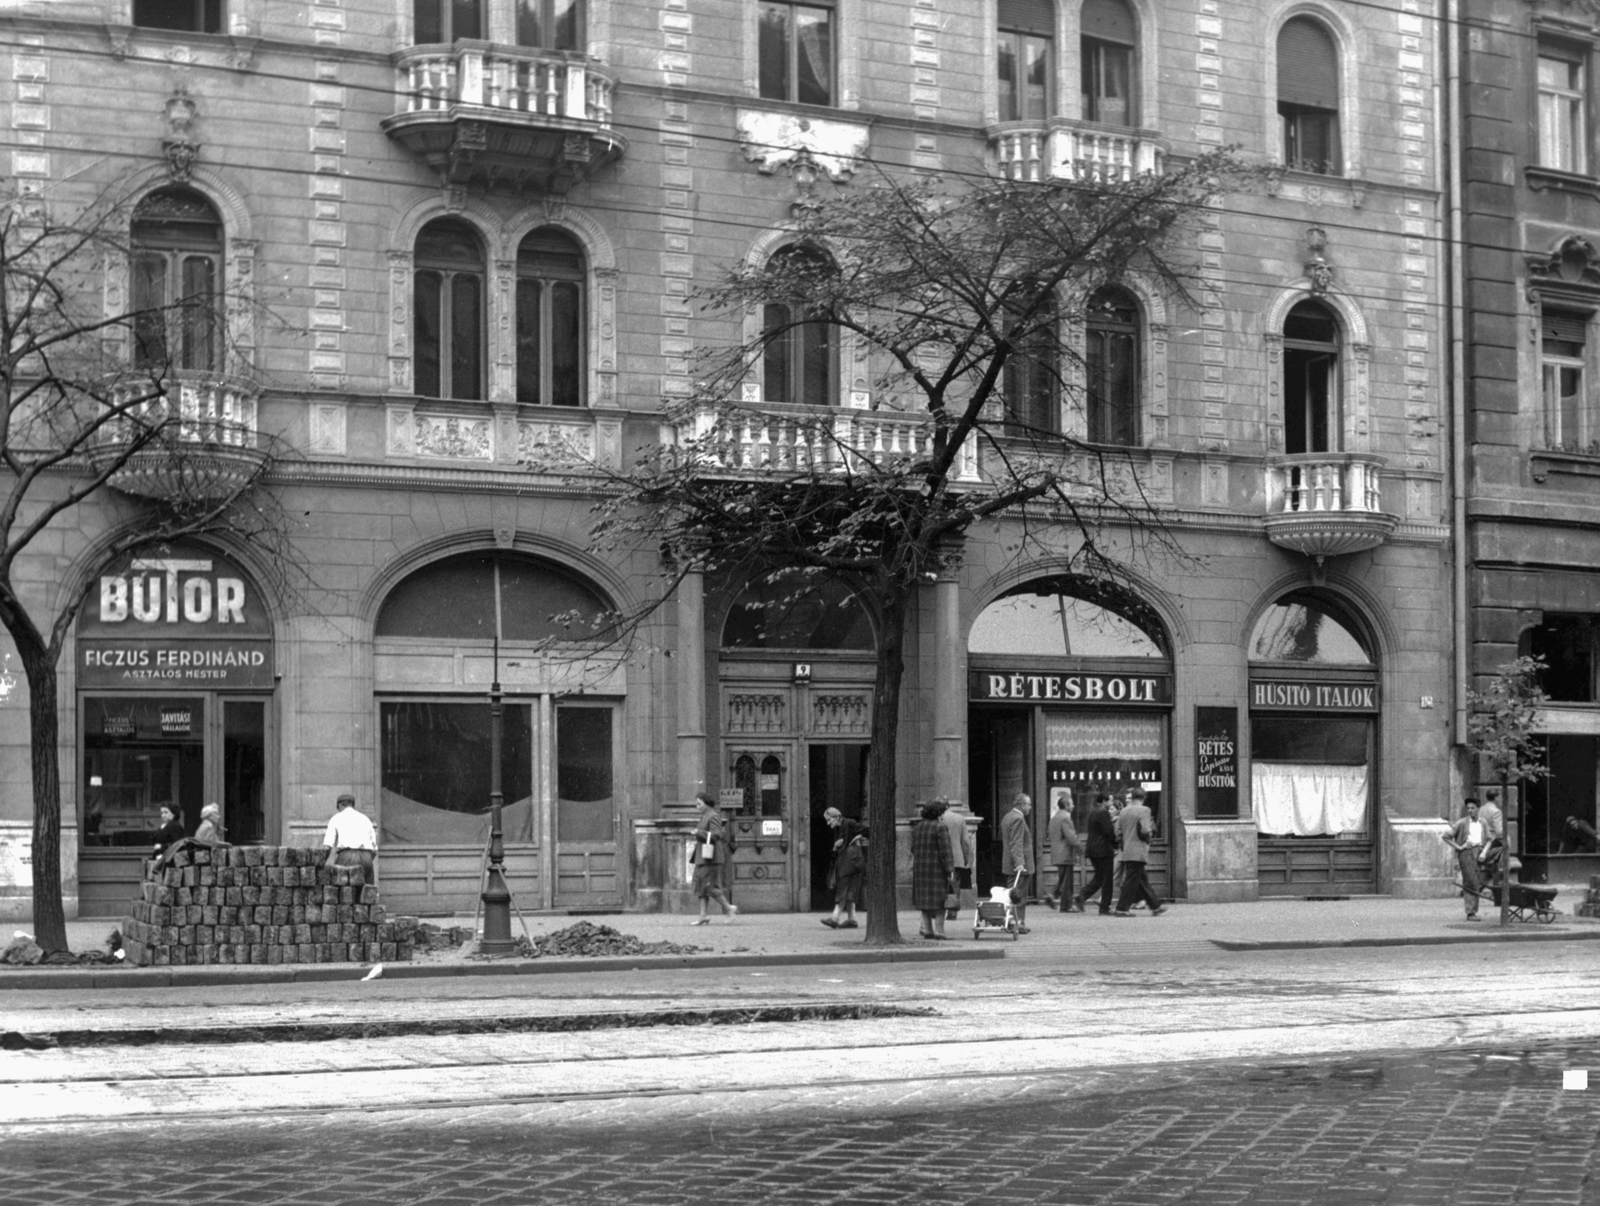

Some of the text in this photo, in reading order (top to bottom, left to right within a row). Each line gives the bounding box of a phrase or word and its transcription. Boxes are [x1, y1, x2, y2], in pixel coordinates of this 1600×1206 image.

[85, 647, 265, 666] FICZUS FERDINÁND
[122, 669, 227, 679] ASZTALOS MESTER
[800, 665, 807, 675] 9
[988, 672, 1157, 701] RÉTESBOLT
[1316, 686, 1374, 707] ITALOK
[1198, 740, 1234, 755] RÉTES
[1130, 770, 1156, 780] KÁVÉ
